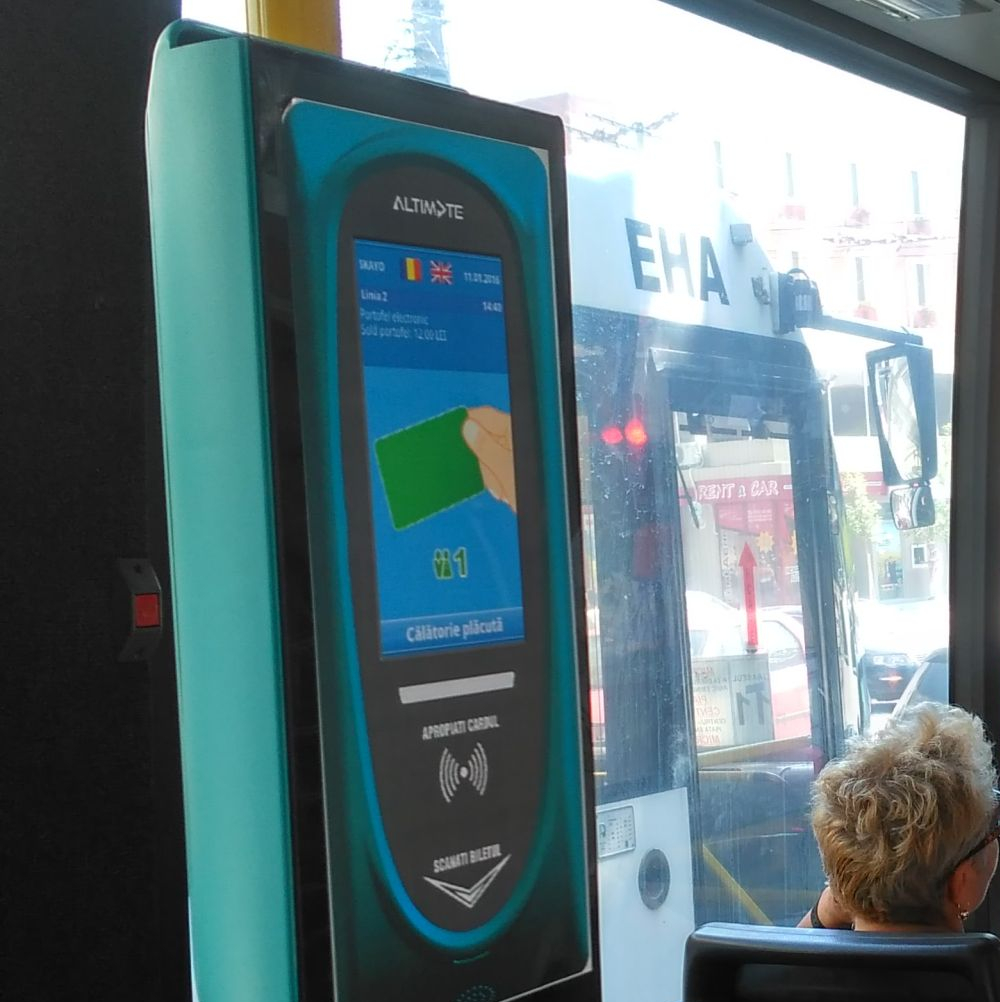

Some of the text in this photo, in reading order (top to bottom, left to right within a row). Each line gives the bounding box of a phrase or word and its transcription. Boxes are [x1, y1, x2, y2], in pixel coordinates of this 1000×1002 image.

[624, 217, 730, 306] EHA
[698, 483, 736, 500] RENT
[750, 480, 780, 497] CAR
[453, 547, 468, 578] 1
[406, 617, 503, 643] Călătorie plăcută
